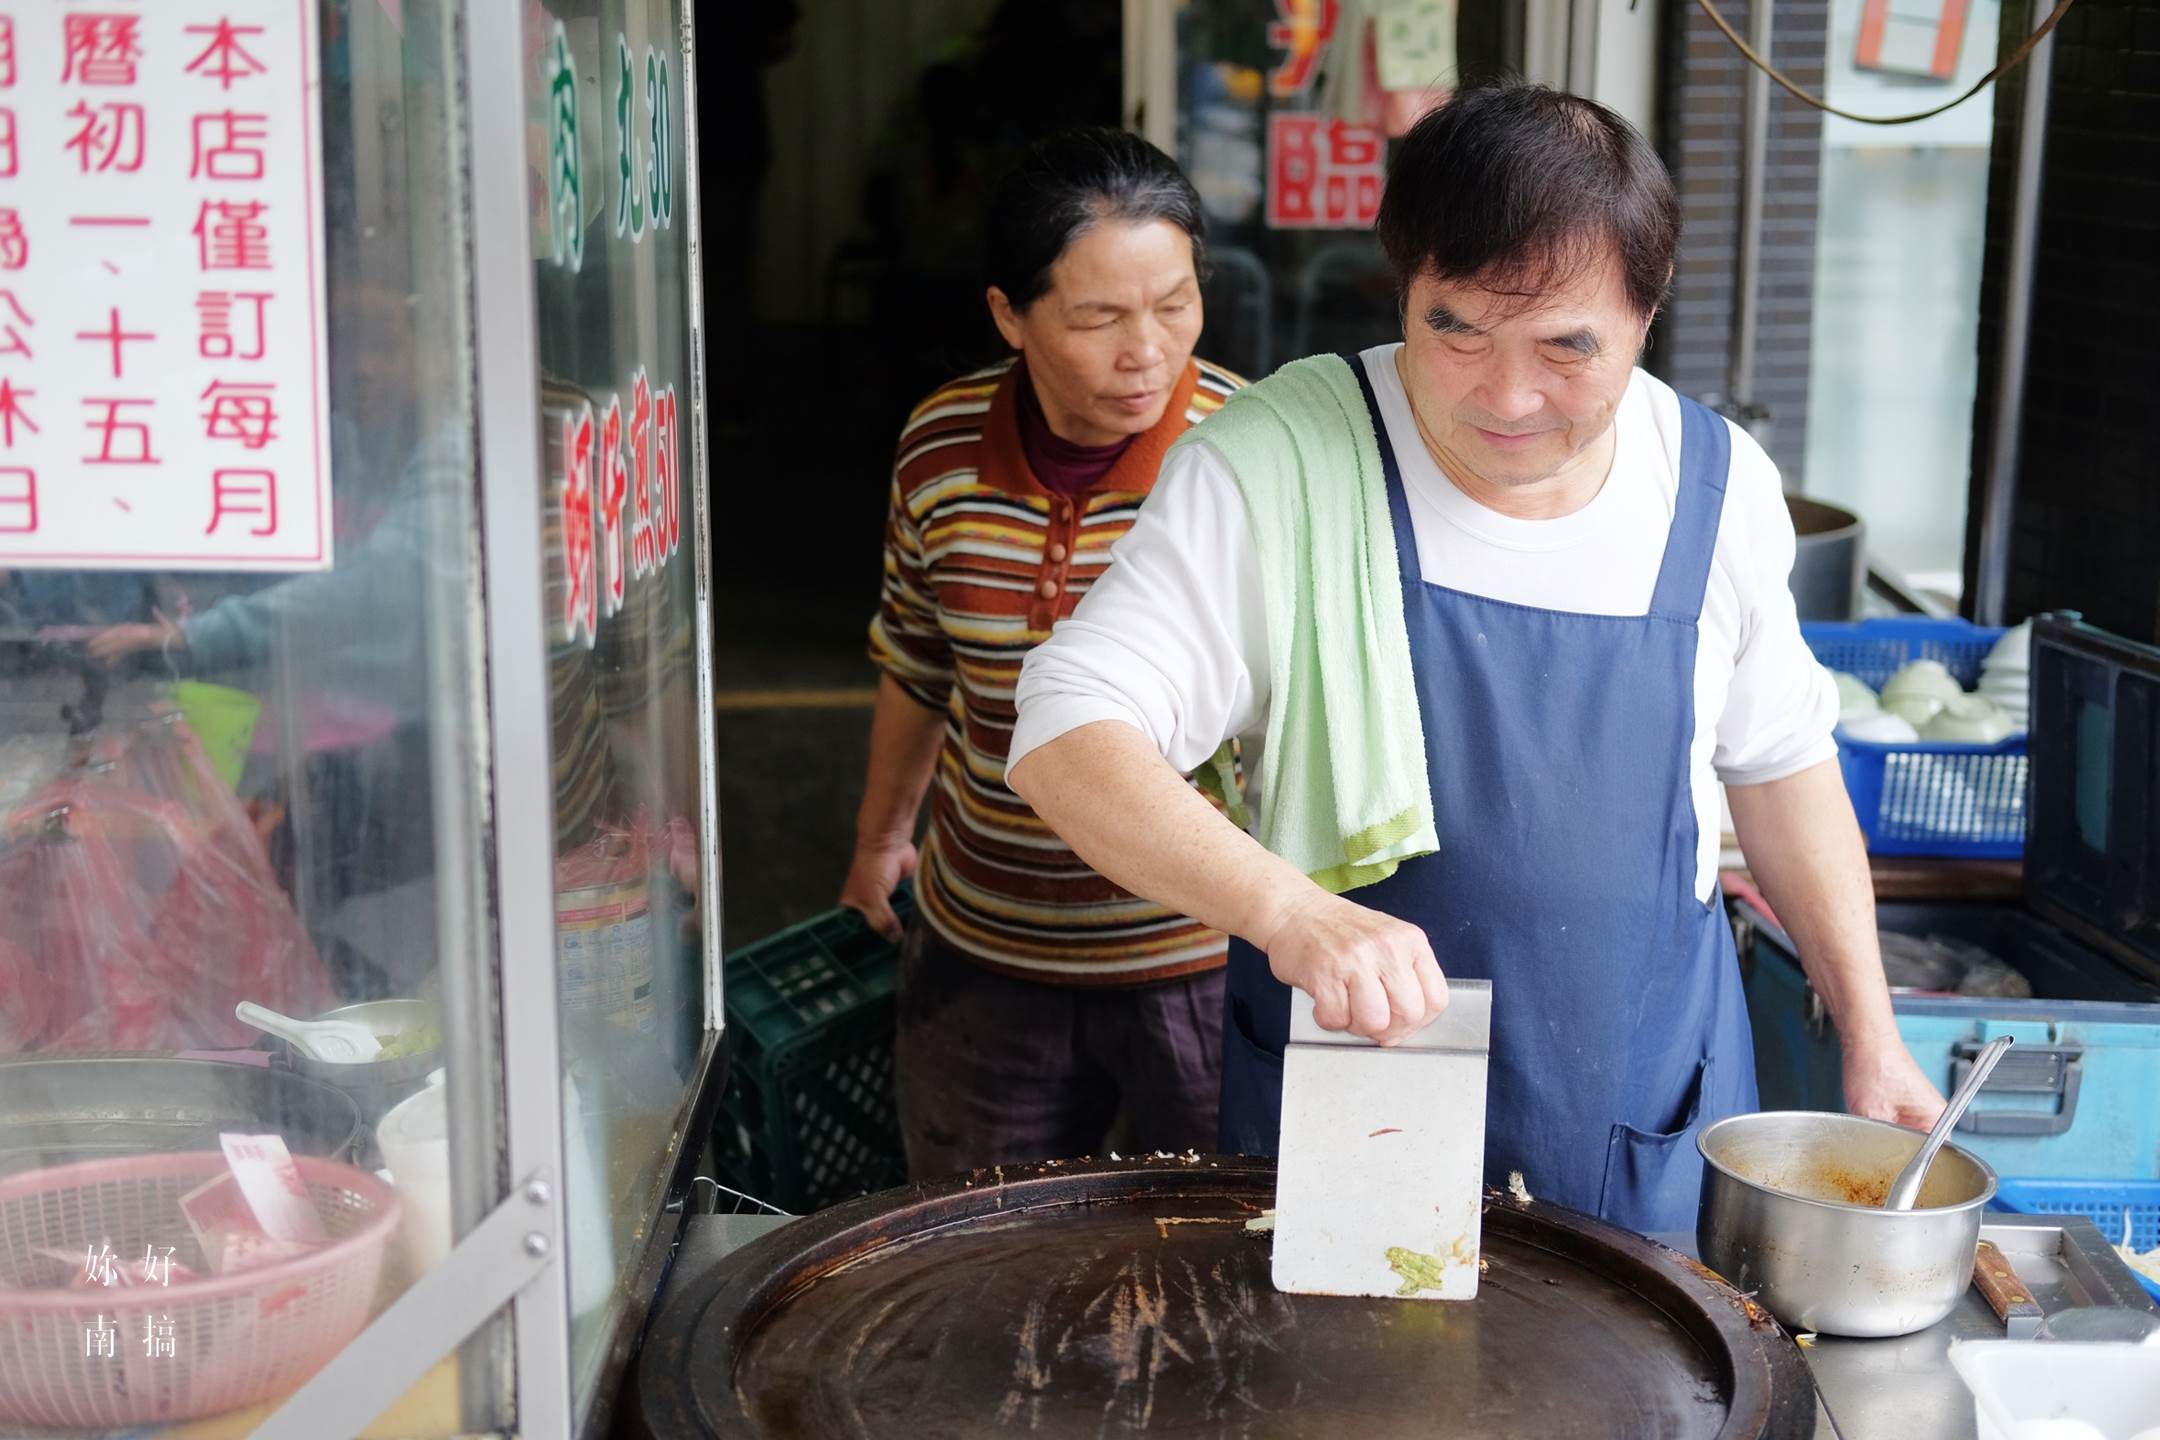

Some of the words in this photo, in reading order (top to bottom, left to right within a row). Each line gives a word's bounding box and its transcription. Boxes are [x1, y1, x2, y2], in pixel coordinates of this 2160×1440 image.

[183, 17, 279, 536] 本店僅訂每月
